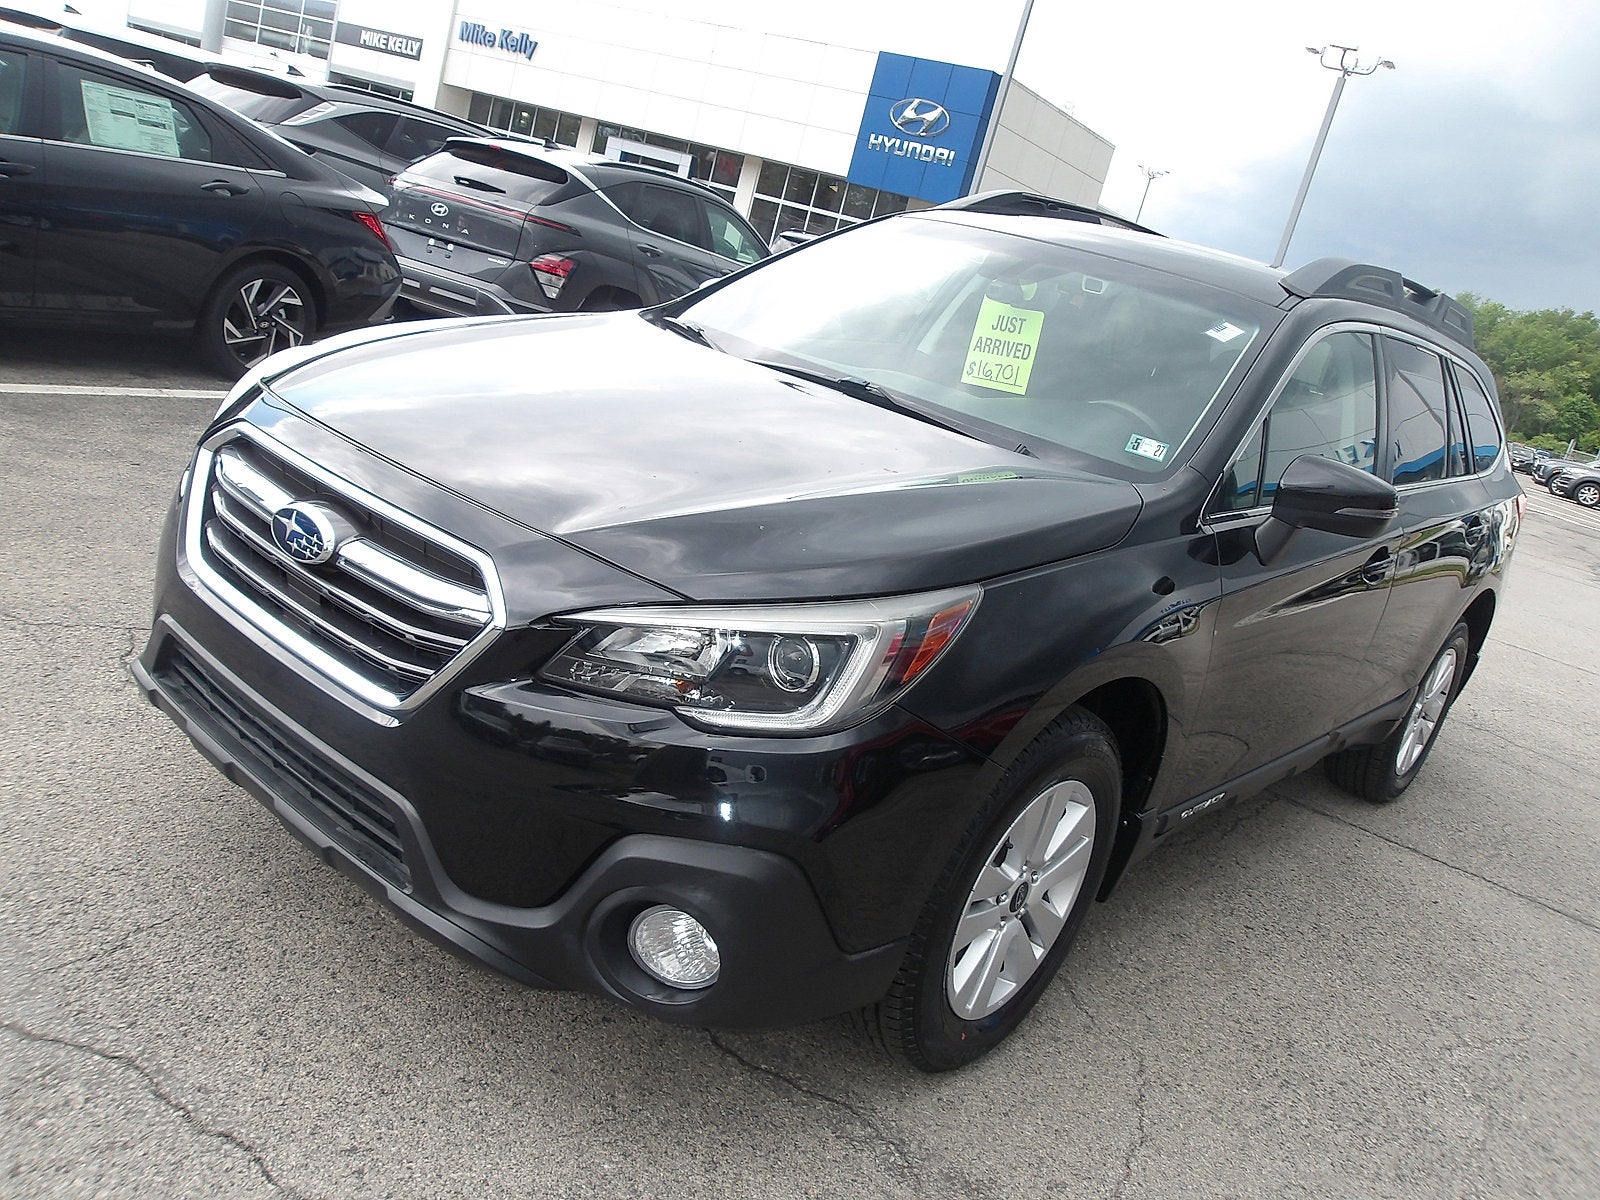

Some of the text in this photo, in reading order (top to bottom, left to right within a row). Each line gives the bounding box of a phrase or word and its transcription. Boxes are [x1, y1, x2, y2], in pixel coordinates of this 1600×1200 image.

[359, 29, 421, 57] MIKE KELLY
[459, 20, 538, 60] Mike Kelly
[868, 133, 956, 167] HYUNDAI
[408, 213, 469, 235] KONA
[991, 315, 1027, 335] JUST
[973, 336, 1032, 361] ARRIVED
[966, 360, 1020, 386] $16,701
